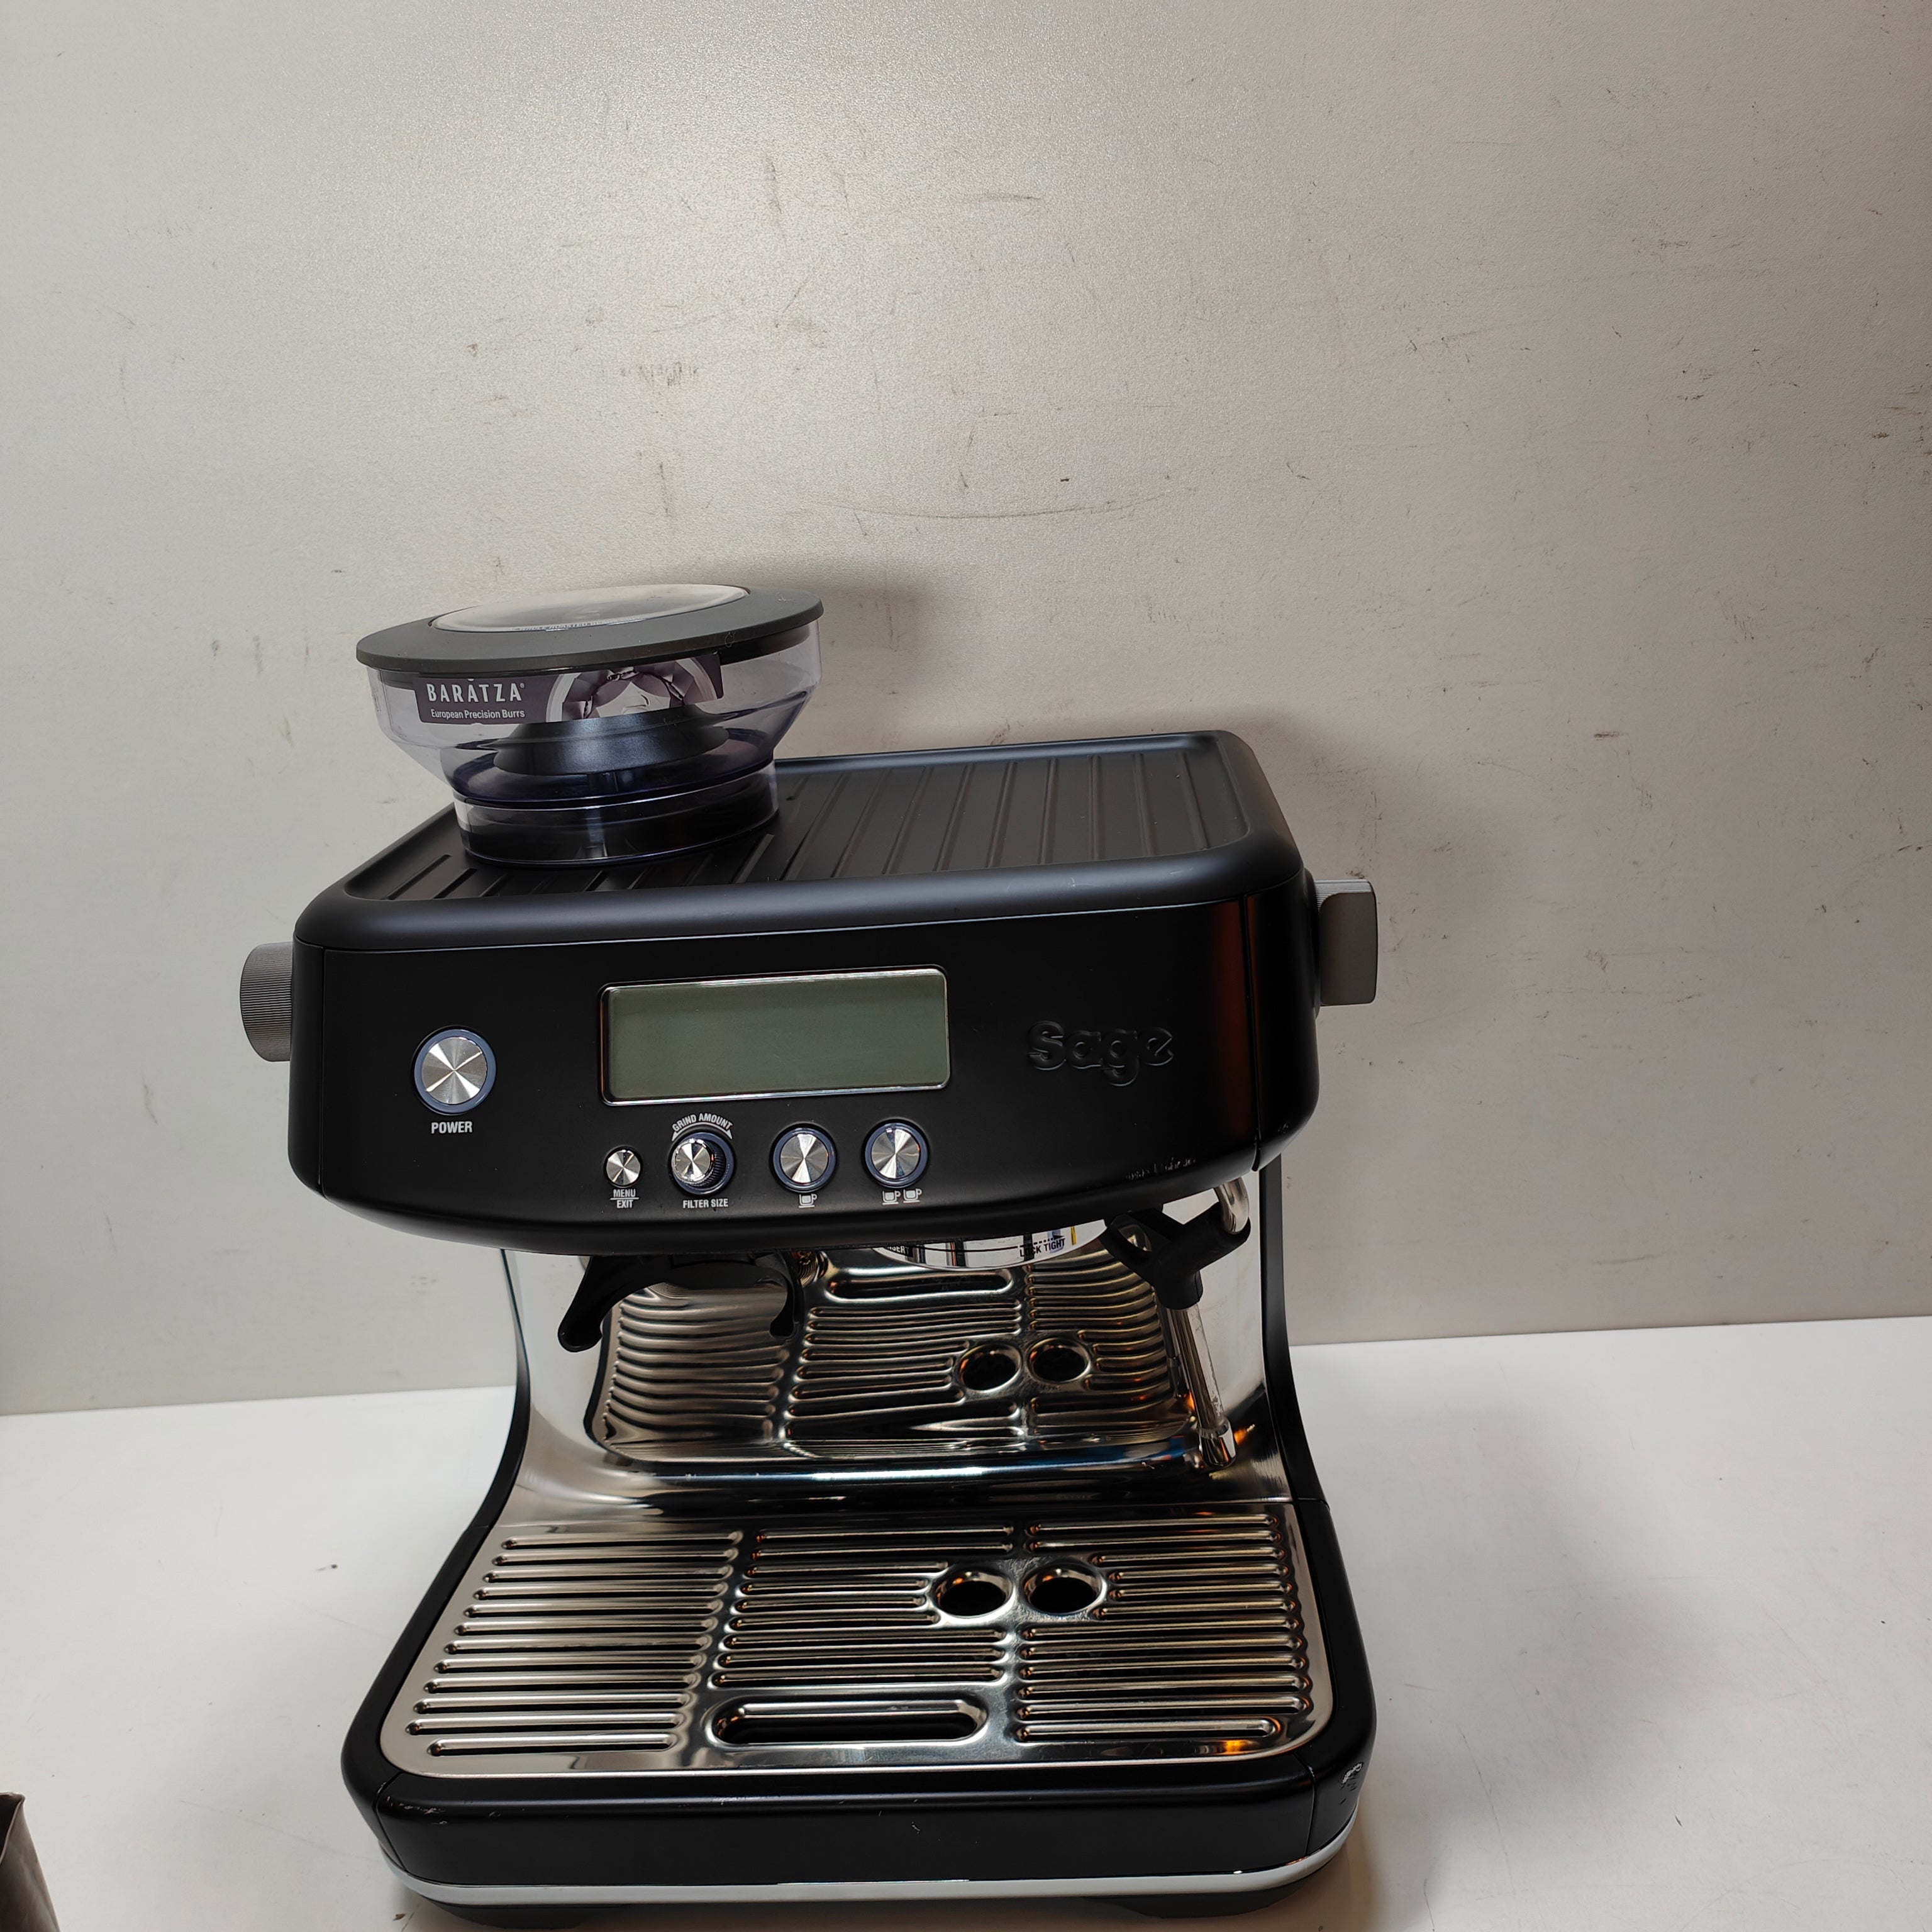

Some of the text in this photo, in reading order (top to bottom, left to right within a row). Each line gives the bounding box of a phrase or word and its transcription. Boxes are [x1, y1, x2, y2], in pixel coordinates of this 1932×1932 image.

[431, 709, 525, 720] European Precision Burrs
[1028, 1021, 1174, 1087] Sage
[431, 1121, 472, 1133] POWER
[672, 1113, 733, 1131] GRIND AMOUNT
[613, 1188, 636, 1197] MENU
[616, 1199, 634, 1209] EXIT
[682, 1198, 728, 1209] FILTER SIZE
[884, 1245, 909, 1255] SERT
[1044, 1238, 1065, 1252] TIGHT
